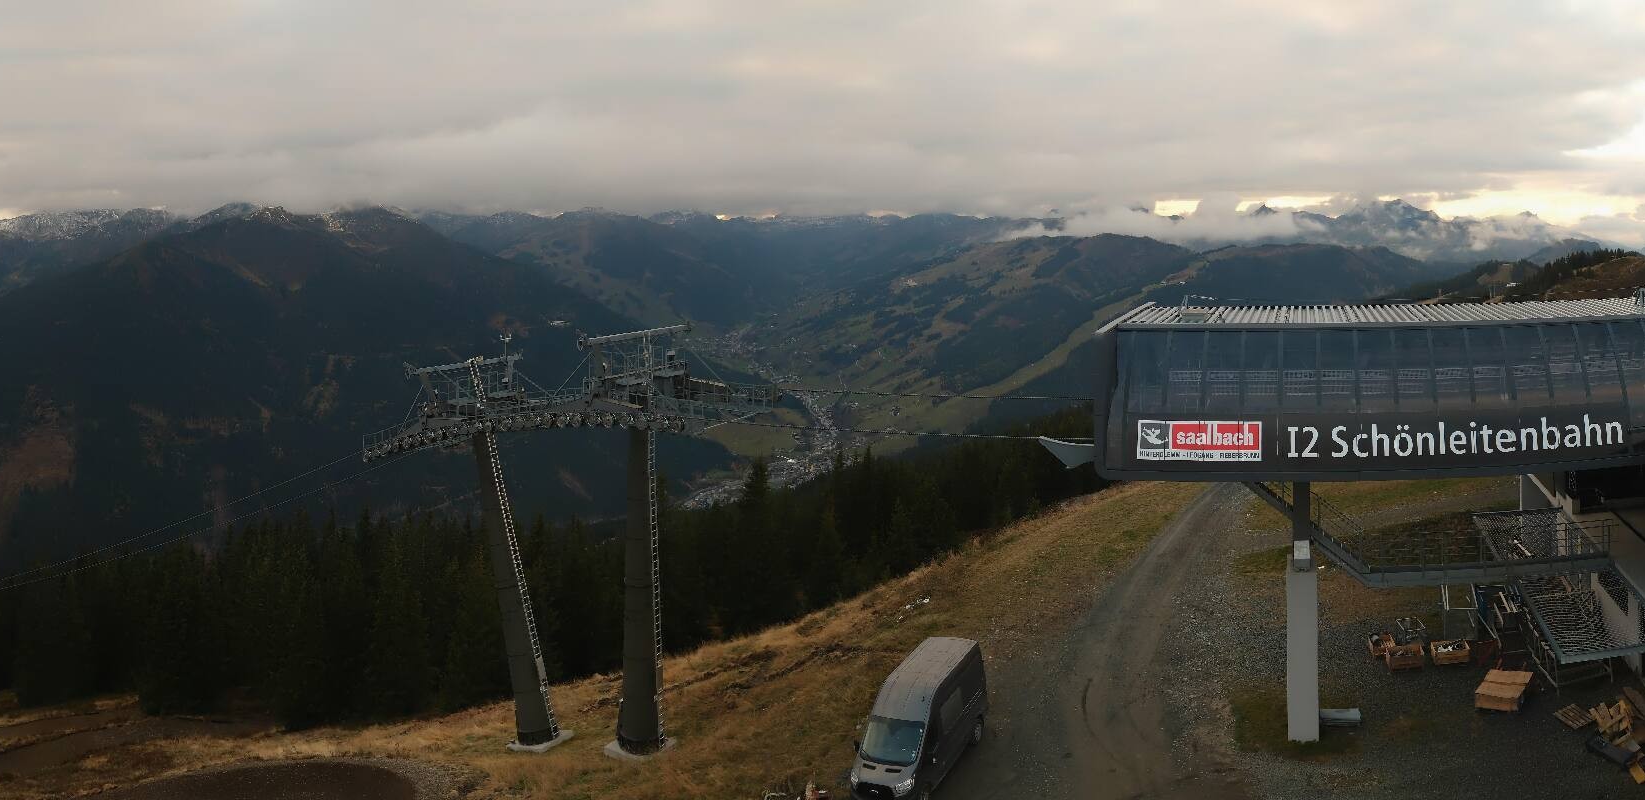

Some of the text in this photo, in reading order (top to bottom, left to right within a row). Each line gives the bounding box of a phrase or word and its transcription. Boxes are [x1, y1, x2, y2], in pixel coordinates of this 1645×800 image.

[1176, 424, 1253, 446] saalbach
[1287, 414, 1624, 458] I2 Schönleitenbahn
